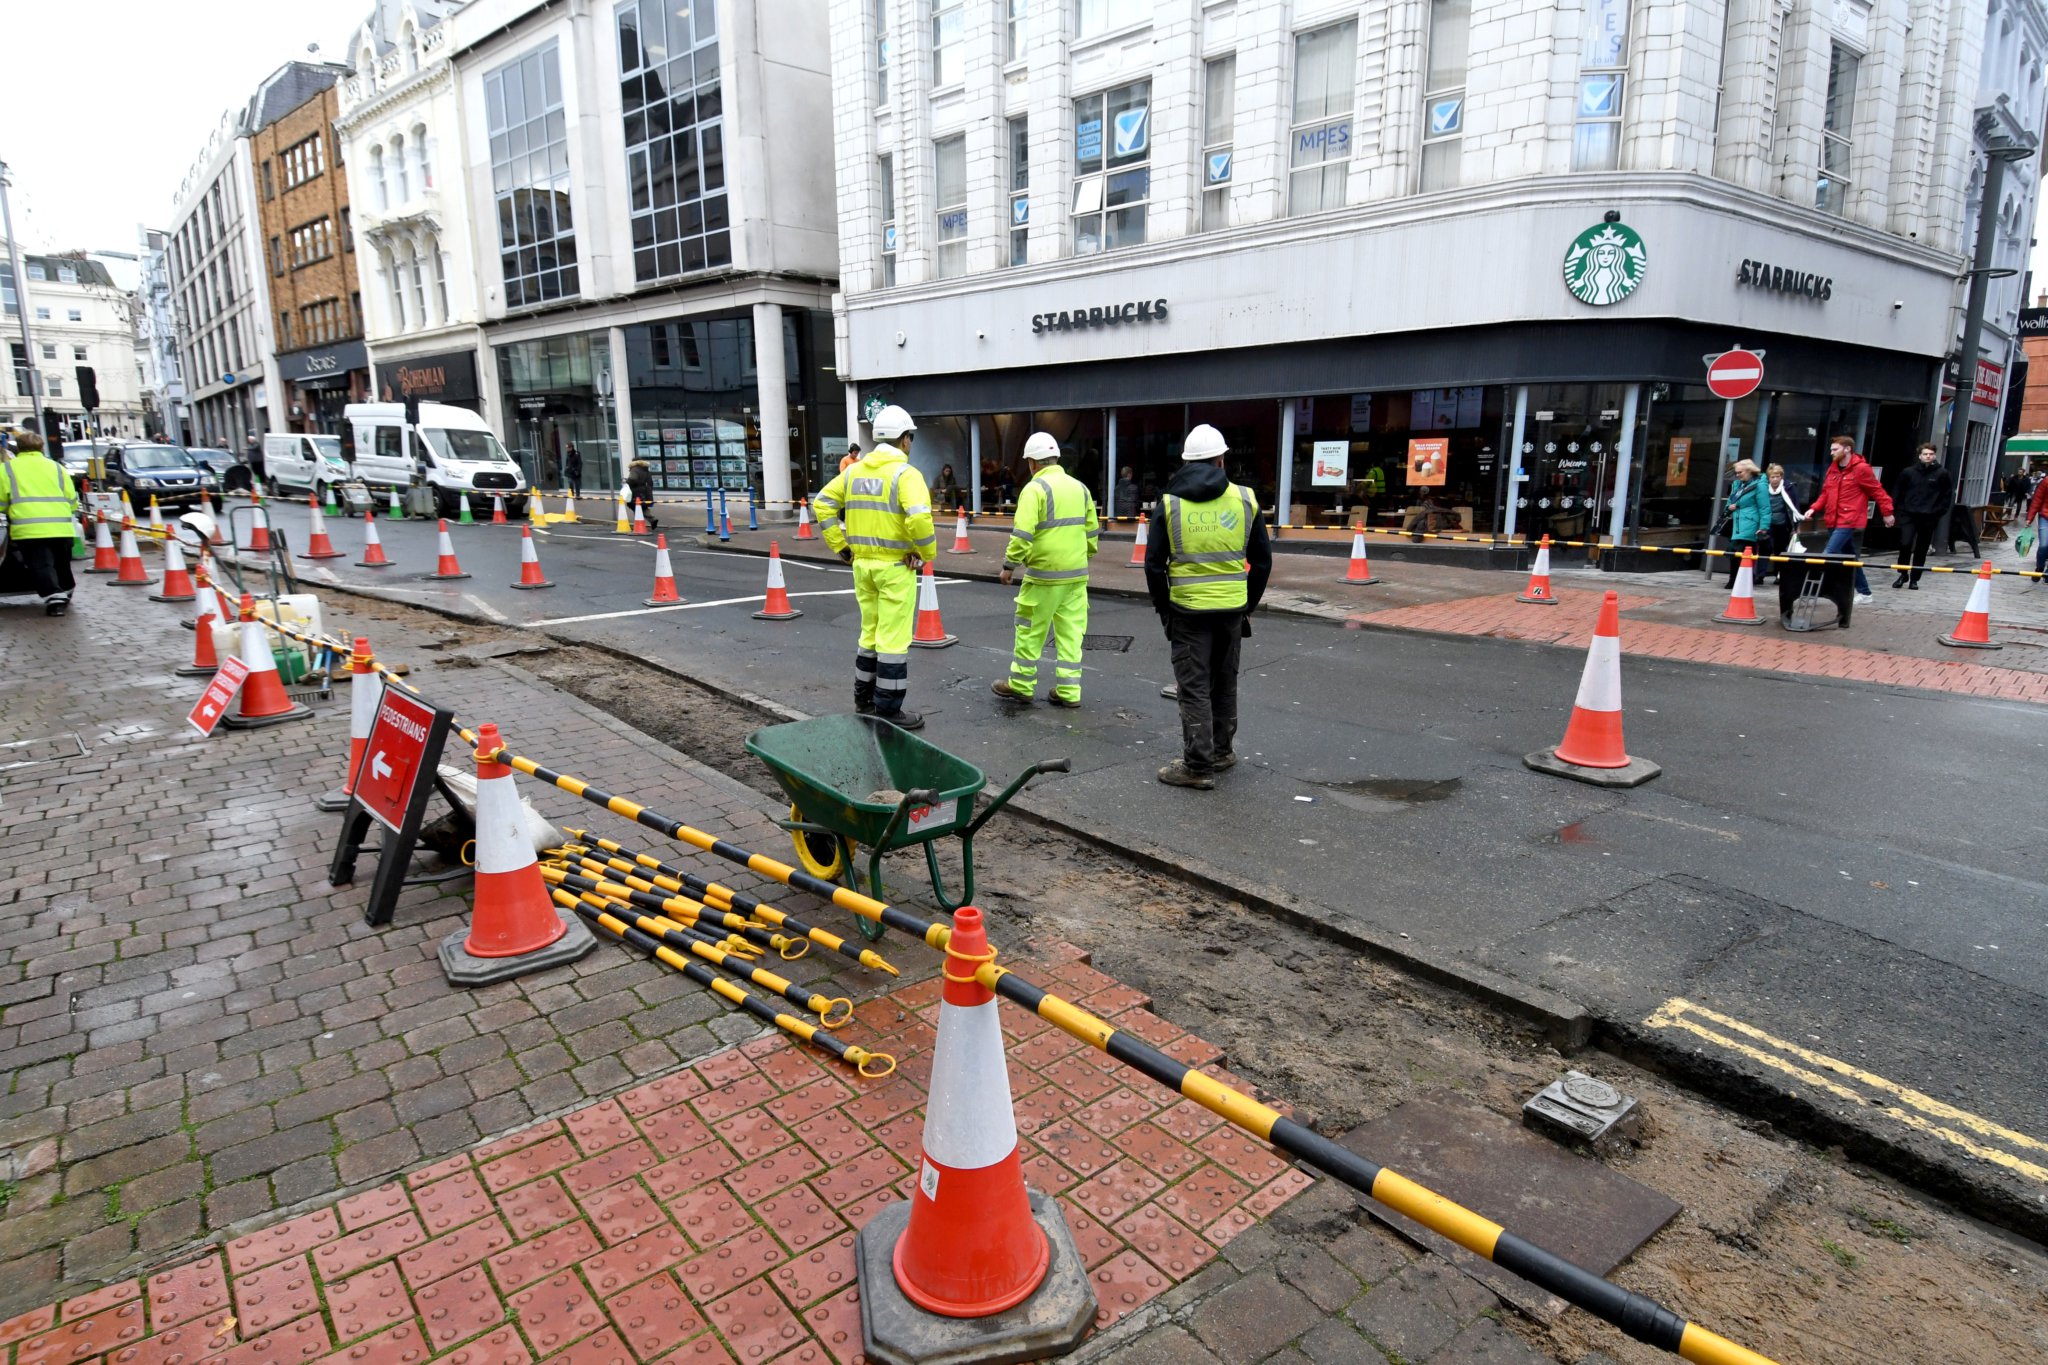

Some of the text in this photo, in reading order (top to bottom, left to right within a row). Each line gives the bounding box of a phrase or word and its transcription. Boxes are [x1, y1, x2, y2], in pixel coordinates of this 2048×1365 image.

[1081, 123, 1098, 132] Learn
[1079, 135, 1099, 145] Qualify
[1299, 124, 1349, 151] MPES
[1082, 148, 1096, 156] Earn
[942, 212, 967, 230] MPE
[1737, 258, 1833, 302] STARBUCKS
[1032, 299, 1168, 334] STARBUCKS
[1558, 459, 1587, 469] Welcome
[1187, 511, 1217, 524] CCJ
[1188, 525, 1218, 533] GROUP
[380, 704, 427, 743] PEDESTRIANS
